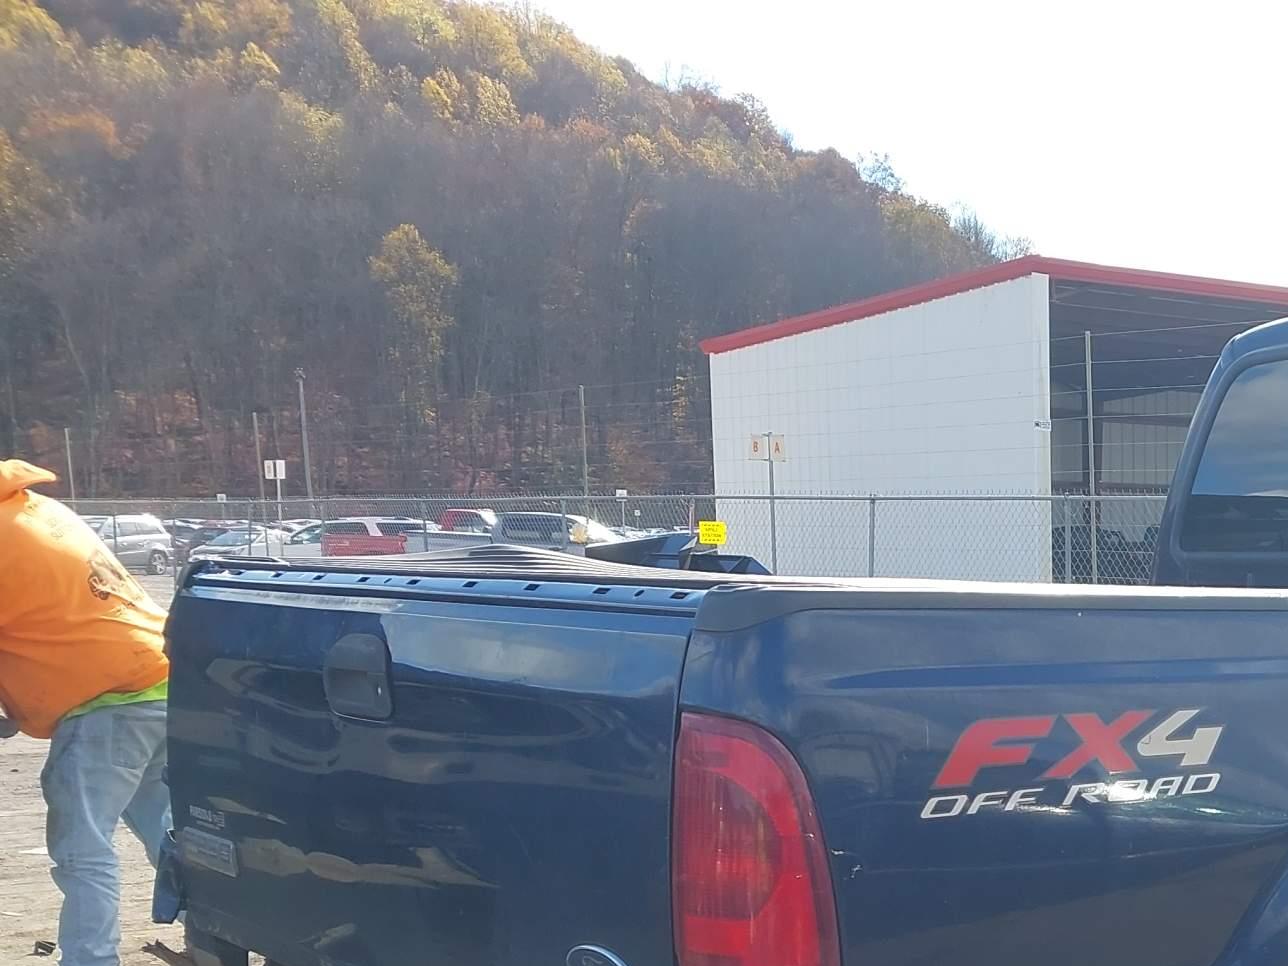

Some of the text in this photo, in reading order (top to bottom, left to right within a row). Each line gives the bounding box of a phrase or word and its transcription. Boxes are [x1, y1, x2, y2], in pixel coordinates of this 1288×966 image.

[752, 440, 759, 453] B
[774, 441, 781, 454] A
[932, 709, 1224, 789] FX4
[920, 773, 1221, 819] OFF ROAD
